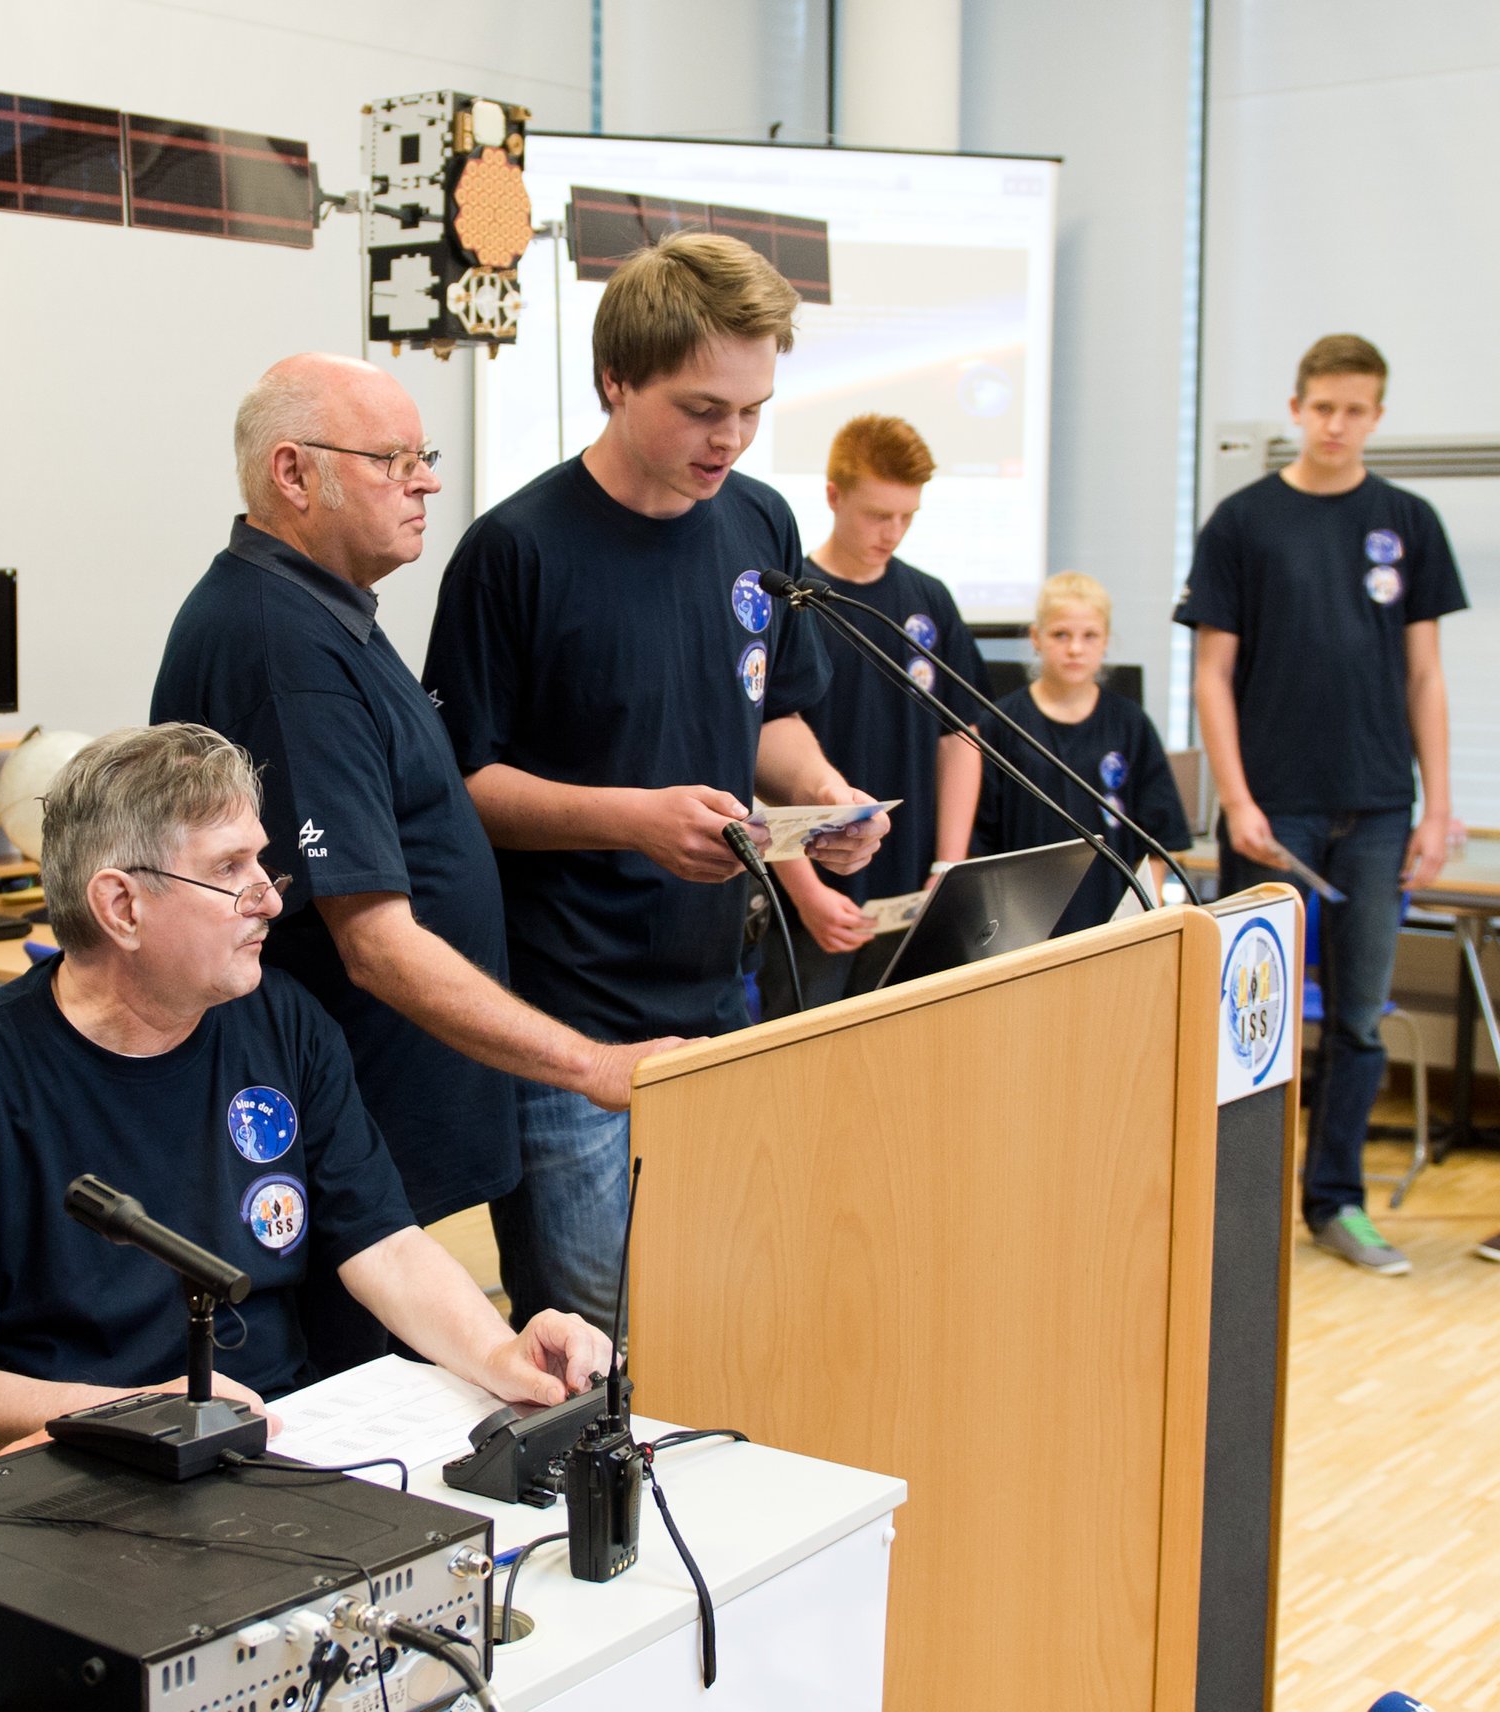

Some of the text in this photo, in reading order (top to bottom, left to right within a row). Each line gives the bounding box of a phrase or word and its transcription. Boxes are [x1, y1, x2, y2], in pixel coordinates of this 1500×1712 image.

[307, 847, 328, 858] DLR
[1240, 1009, 1268, 1044] ISS
[235, 1099, 274, 1117] blue dot
[267, 1217, 294, 1237] ISS
